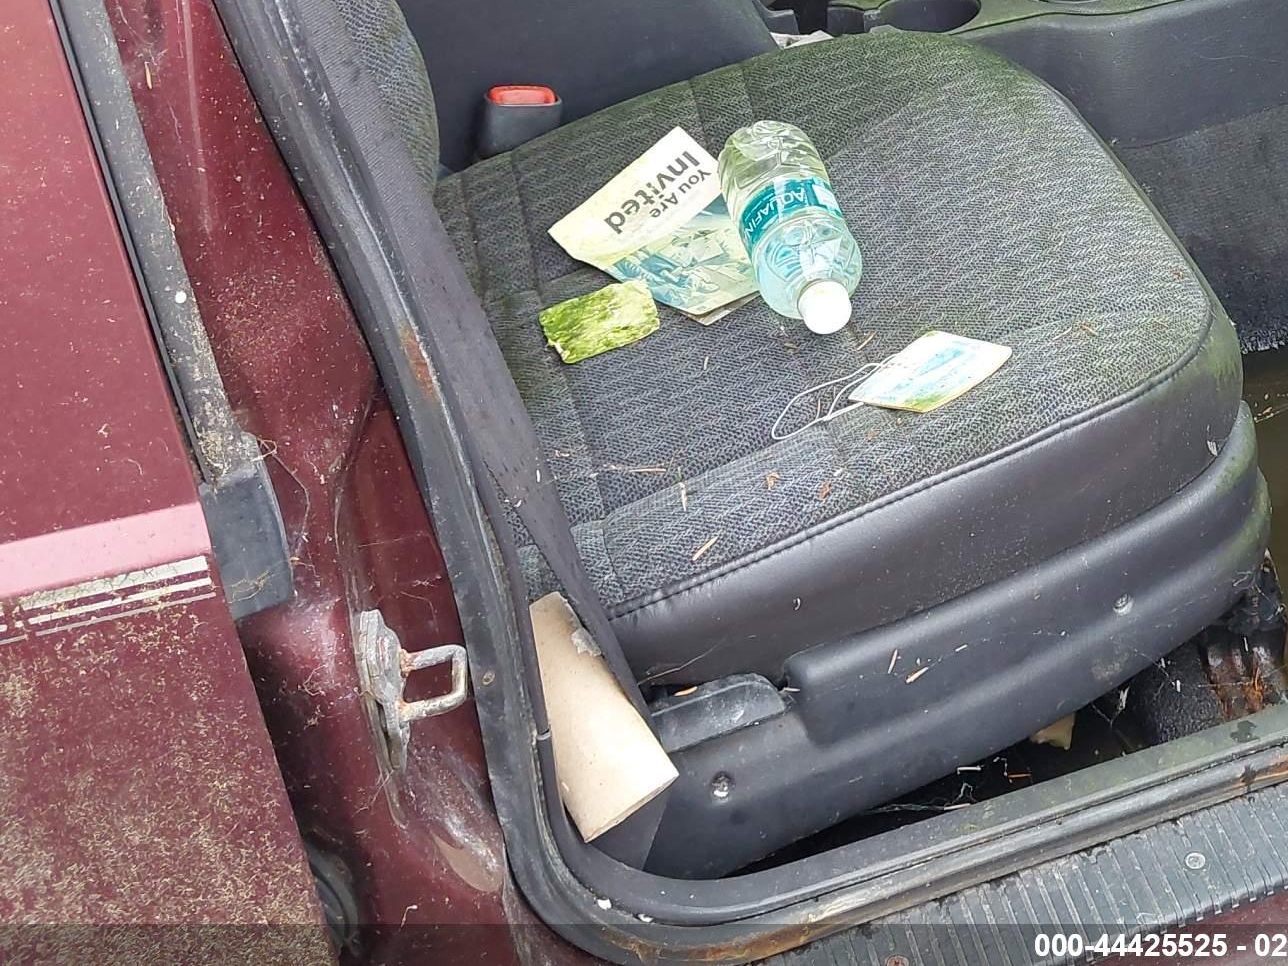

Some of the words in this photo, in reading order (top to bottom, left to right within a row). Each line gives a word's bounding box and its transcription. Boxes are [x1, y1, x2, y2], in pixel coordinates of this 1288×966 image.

[604, 150, 700, 234] Invited
[678, 169, 712, 194] You
[649, 192, 679, 218] Are
